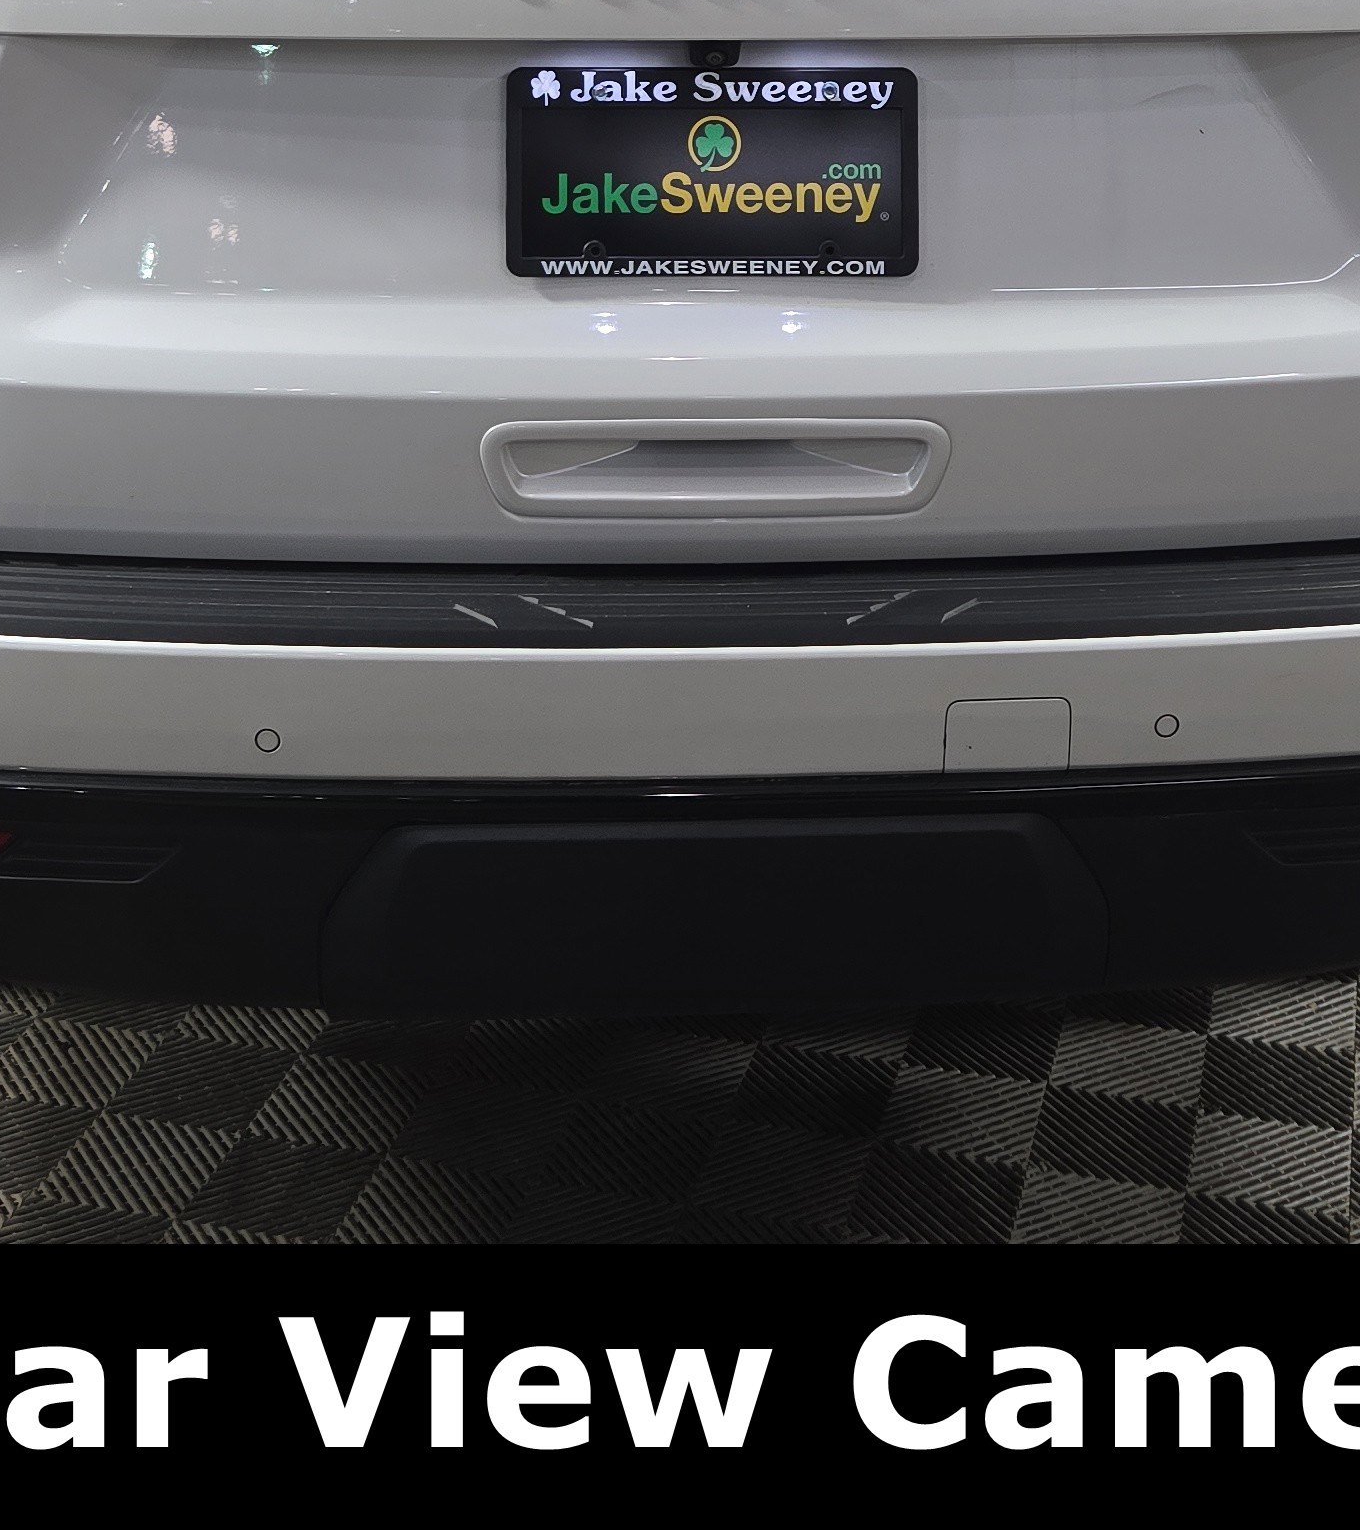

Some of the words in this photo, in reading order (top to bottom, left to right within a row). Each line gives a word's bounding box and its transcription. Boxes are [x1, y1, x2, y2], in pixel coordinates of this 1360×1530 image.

[570, 71, 677, 102] Jake
[693, 71, 894, 109] Sweeney
[541, 260, 886, 275] WWW.JAKESWEENEY.COM
